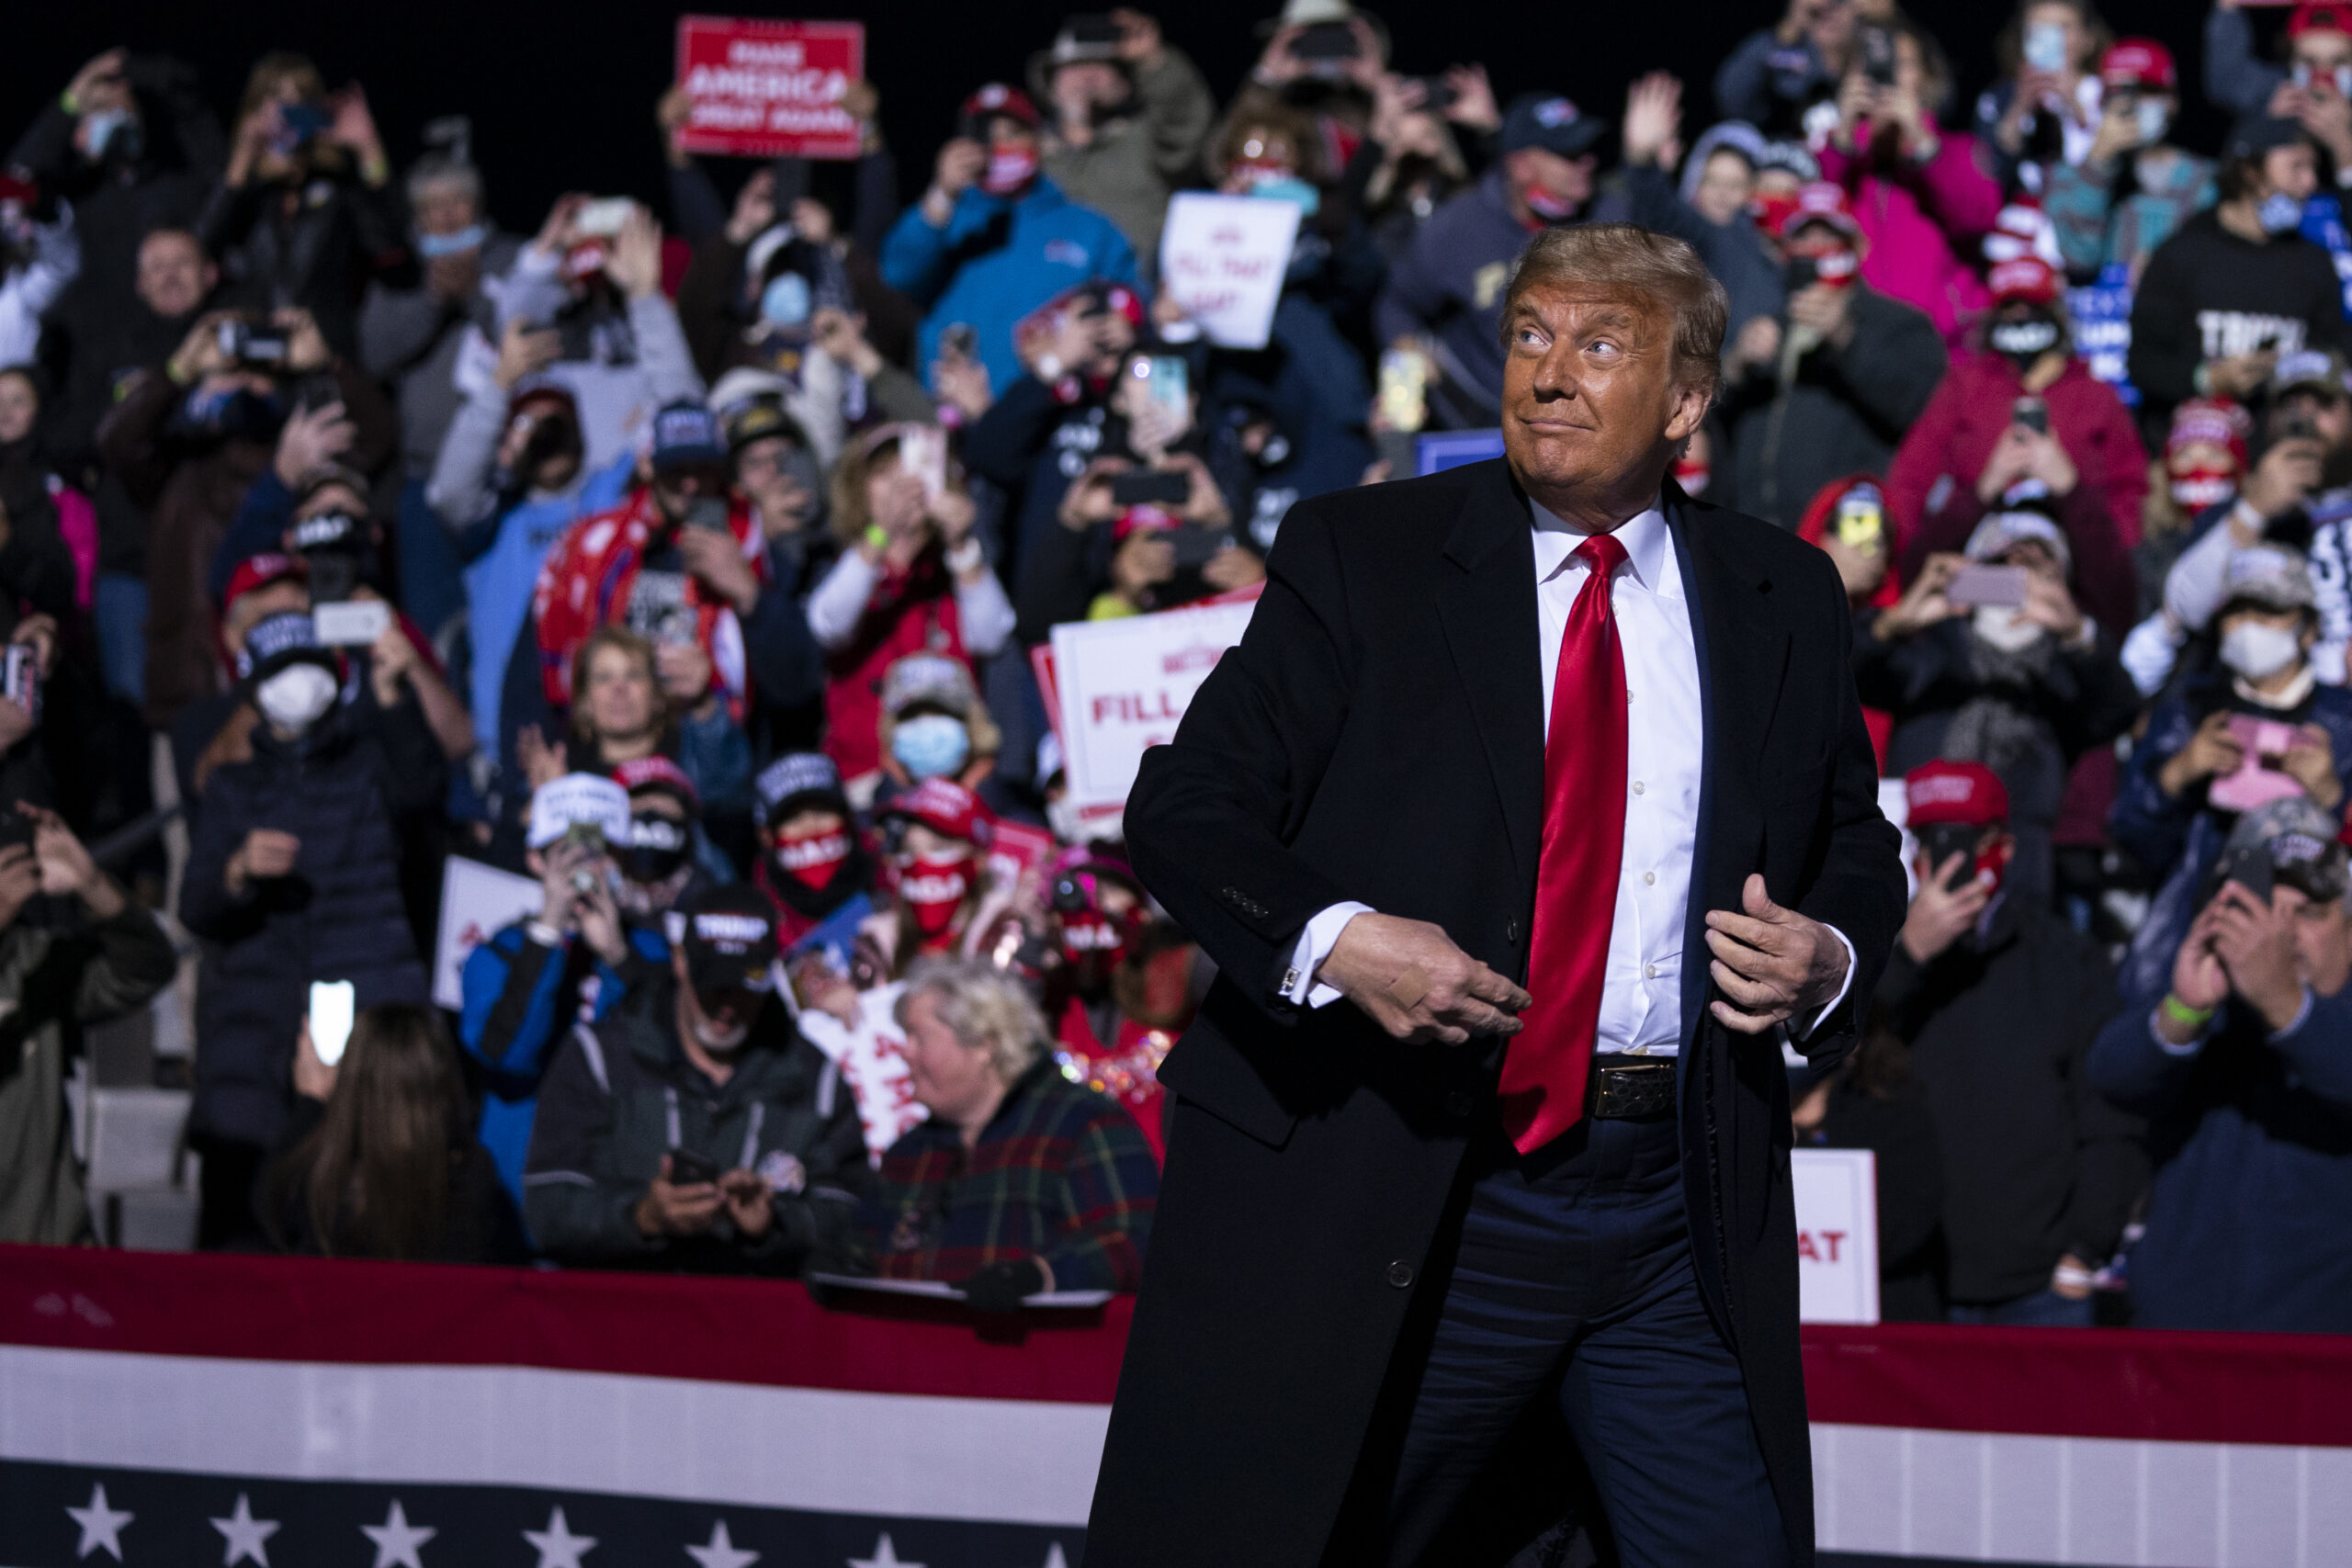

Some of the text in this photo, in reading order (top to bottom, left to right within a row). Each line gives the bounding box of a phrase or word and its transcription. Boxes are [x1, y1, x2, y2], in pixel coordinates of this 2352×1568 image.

[688, 65, 847, 102] AMERICA
[1092, 692, 1181, 726] FILL
[695, 913, 769, 942] TRUMP
[1798, 1228, 1848, 1263] AT
